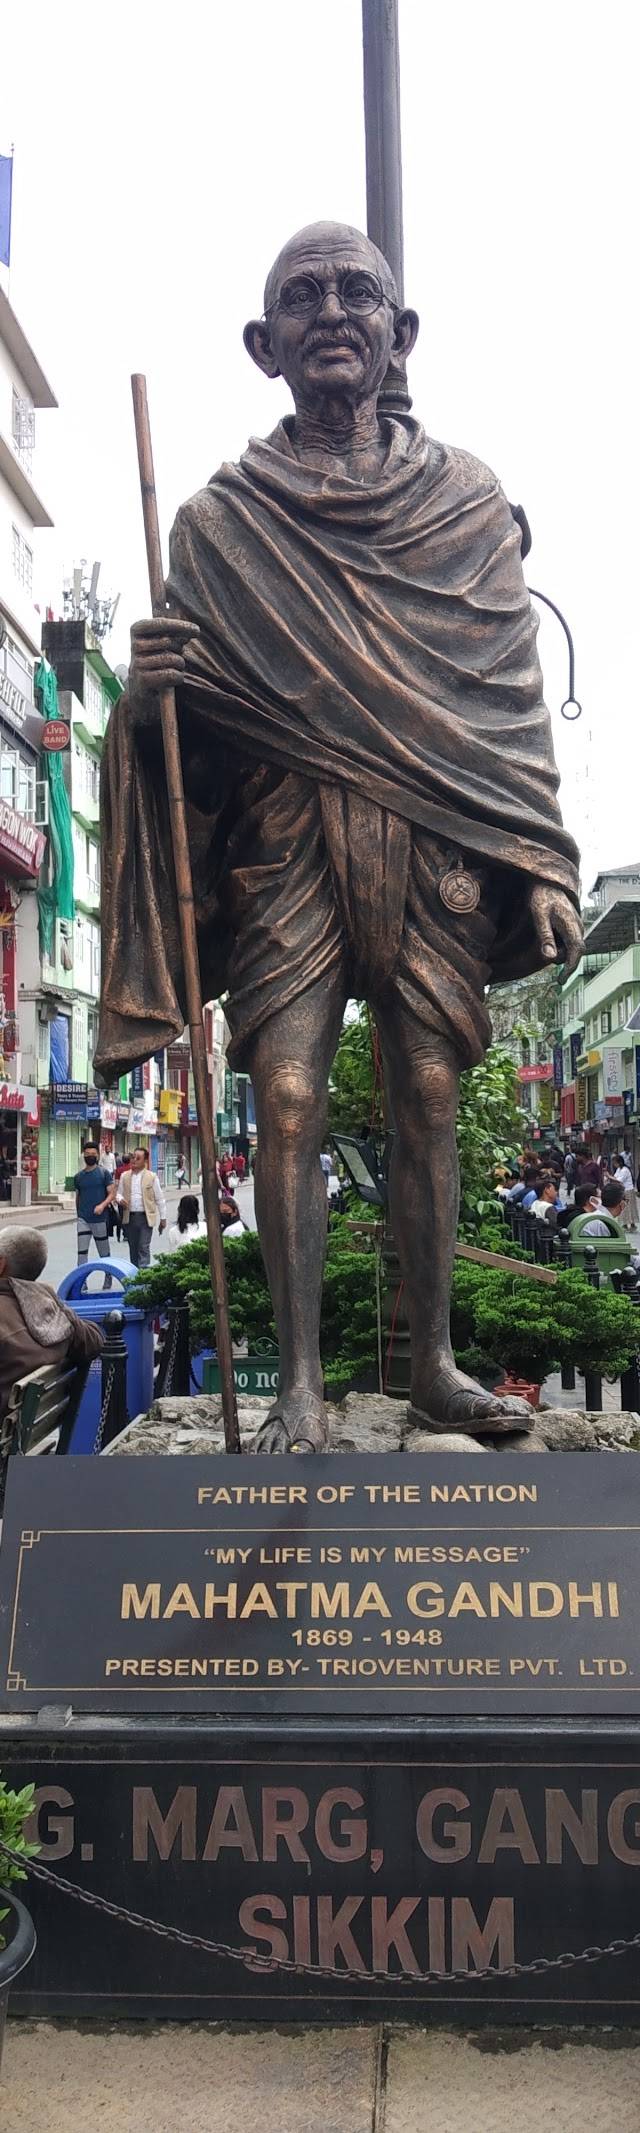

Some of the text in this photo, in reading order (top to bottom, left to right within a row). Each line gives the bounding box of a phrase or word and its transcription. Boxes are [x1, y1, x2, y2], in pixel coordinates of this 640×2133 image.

[18, 822, 38, 854] WOK
[56, 1084, 87, 1092] DESIRE
[197, 1485, 537, 1504] FATHER OF THE NATION
[260, 1547, 311, 1563] LIFE
[320, 1547, 341, 1563] IS
[350, 1547, 388, 1563] MY
[121, 1581, 620, 1620] MAHATMA GANDHI
[292, 1629, 353, 1646] 1869
[381, 1629, 442, 1645] 1948
[105, 1659, 634, 1676] PRESENTED BY- TRIOVENTURE PVT. LTD.
[133, 1785, 384, 1873] MARG,
[416, 1787, 640, 1866] GANG
[239, 1894, 515, 1974] SIKKIM
